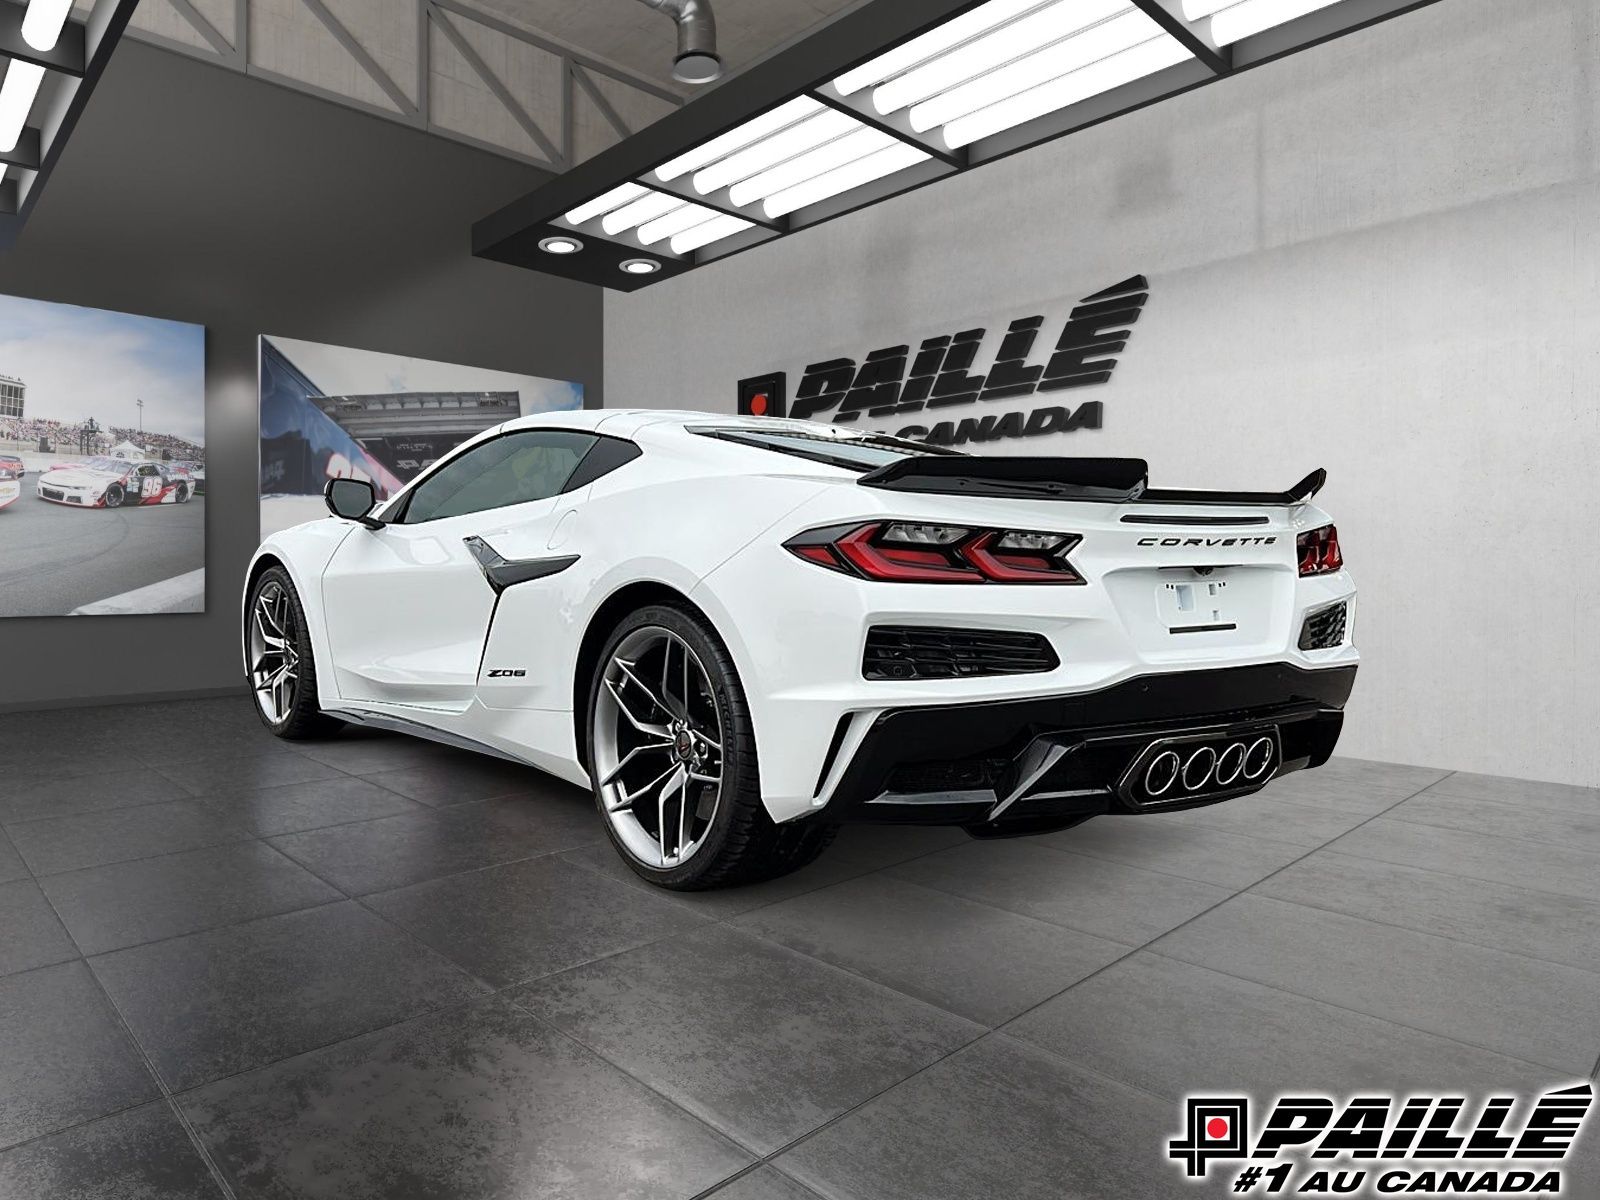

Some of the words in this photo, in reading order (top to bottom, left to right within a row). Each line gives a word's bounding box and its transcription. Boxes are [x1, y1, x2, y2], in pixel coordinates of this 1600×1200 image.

[788, 274, 1149, 423] PAILLÉ
[1136, 536, 1277, 547] CORVETTE
[487, 669, 526, 677] Z06
